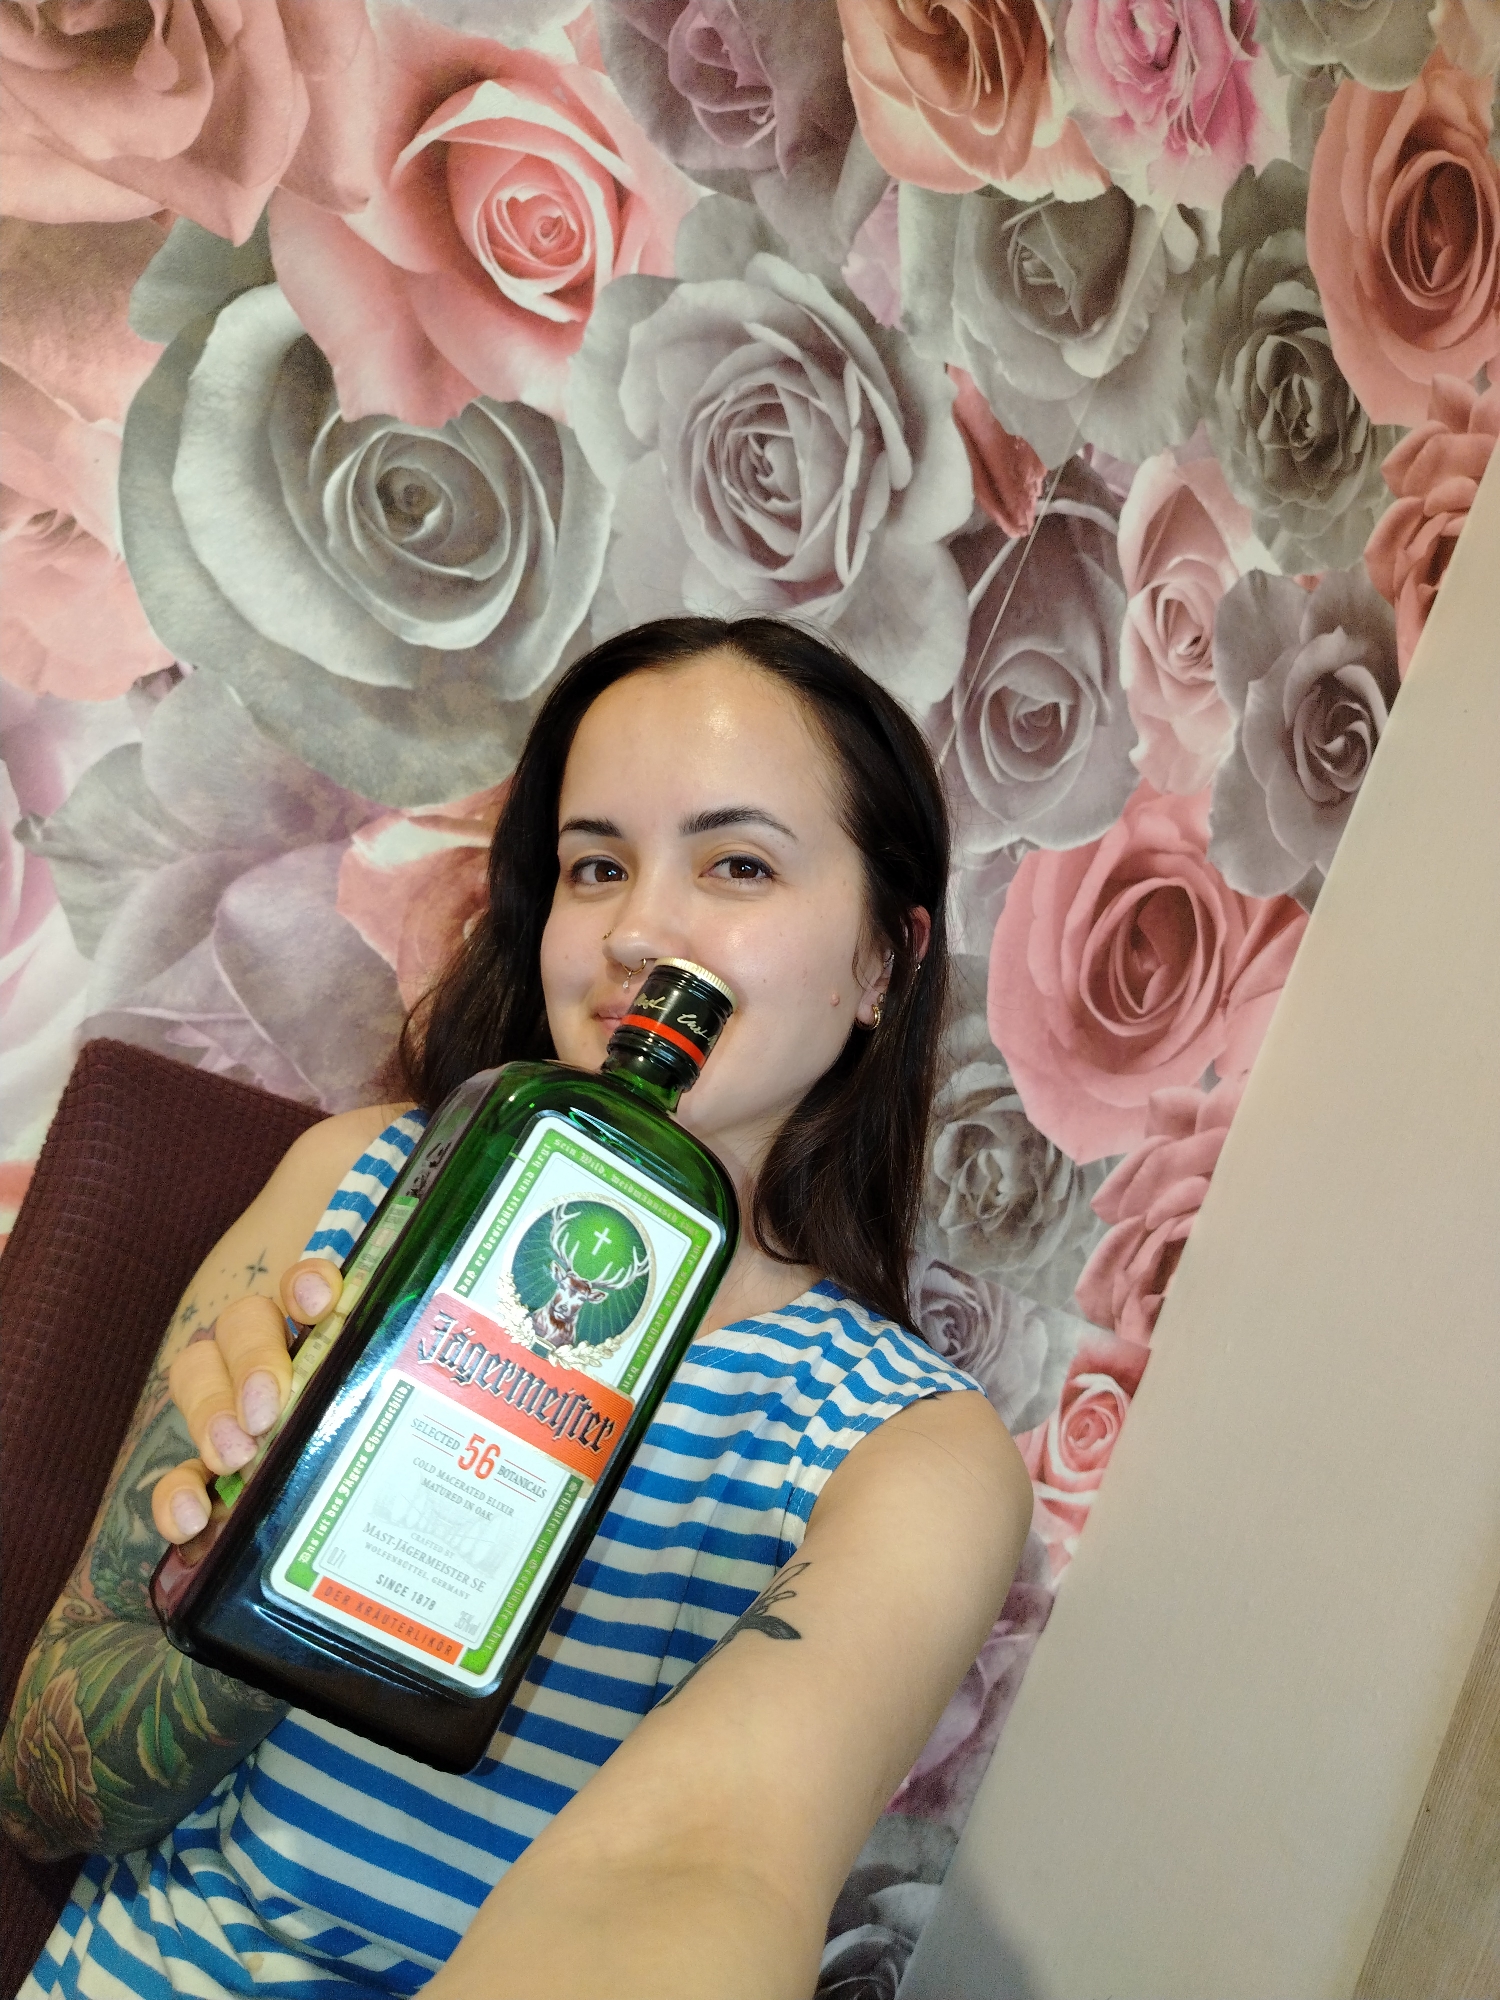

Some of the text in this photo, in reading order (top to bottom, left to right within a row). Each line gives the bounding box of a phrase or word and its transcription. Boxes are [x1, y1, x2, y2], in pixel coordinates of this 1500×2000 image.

[552, 1136, 577, 1156] sein
[473, 1253, 487, 1268] er
[517, 1169, 536, 1194] und
[530, 1142, 553, 1169] hegt
[621, 1365, 639, 1389] den
[409, 1416, 548, 1499] SELECTED 56 BOTANICALS
[411, 1455, 516, 1518] COLD MACERATED ELIXIR
[420, 1476, 494, 1522] MATURED IN OAK
[297, 1537, 320, 1565] Das
[313, 1517, 331, 1537] ist
[361, 1520, 487, 1593] MAST-JÄGERMEISTER SE
[409, 1531, 456, 1559] CRAFTED BY
[534, 1538, 547, 1555] im
[374, 1572, 437, 1612] SINCE 1878
[429, 1575, 470, 1601] GERMANY
[322, 1584, 455, 1657] DER KRÄUTERLIKÖR
